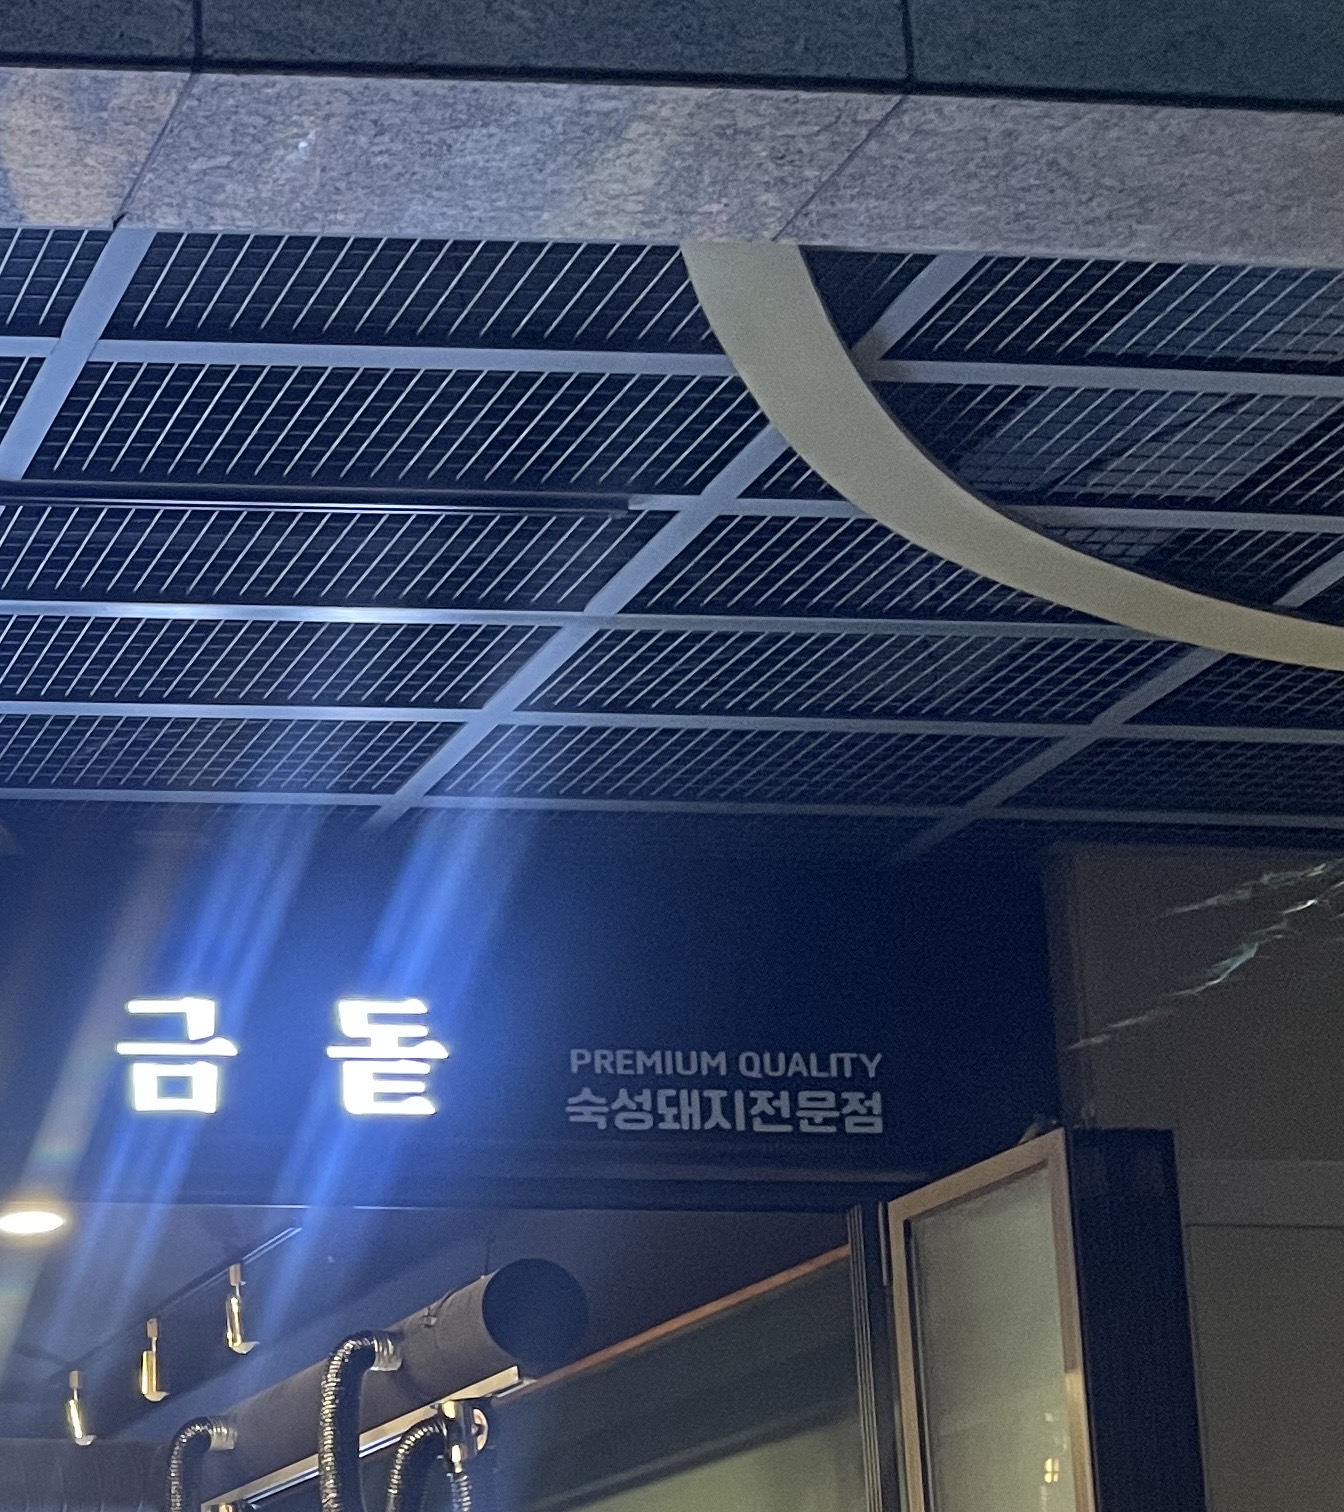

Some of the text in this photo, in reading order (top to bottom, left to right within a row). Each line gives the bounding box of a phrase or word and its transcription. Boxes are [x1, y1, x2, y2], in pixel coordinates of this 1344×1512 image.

[115, 996, 240, 1114] 금
[568, 1047, 884, 1079] PREMIUM QUALITY
[564, 1086, 885, 1134] 숙성돼지전문점
